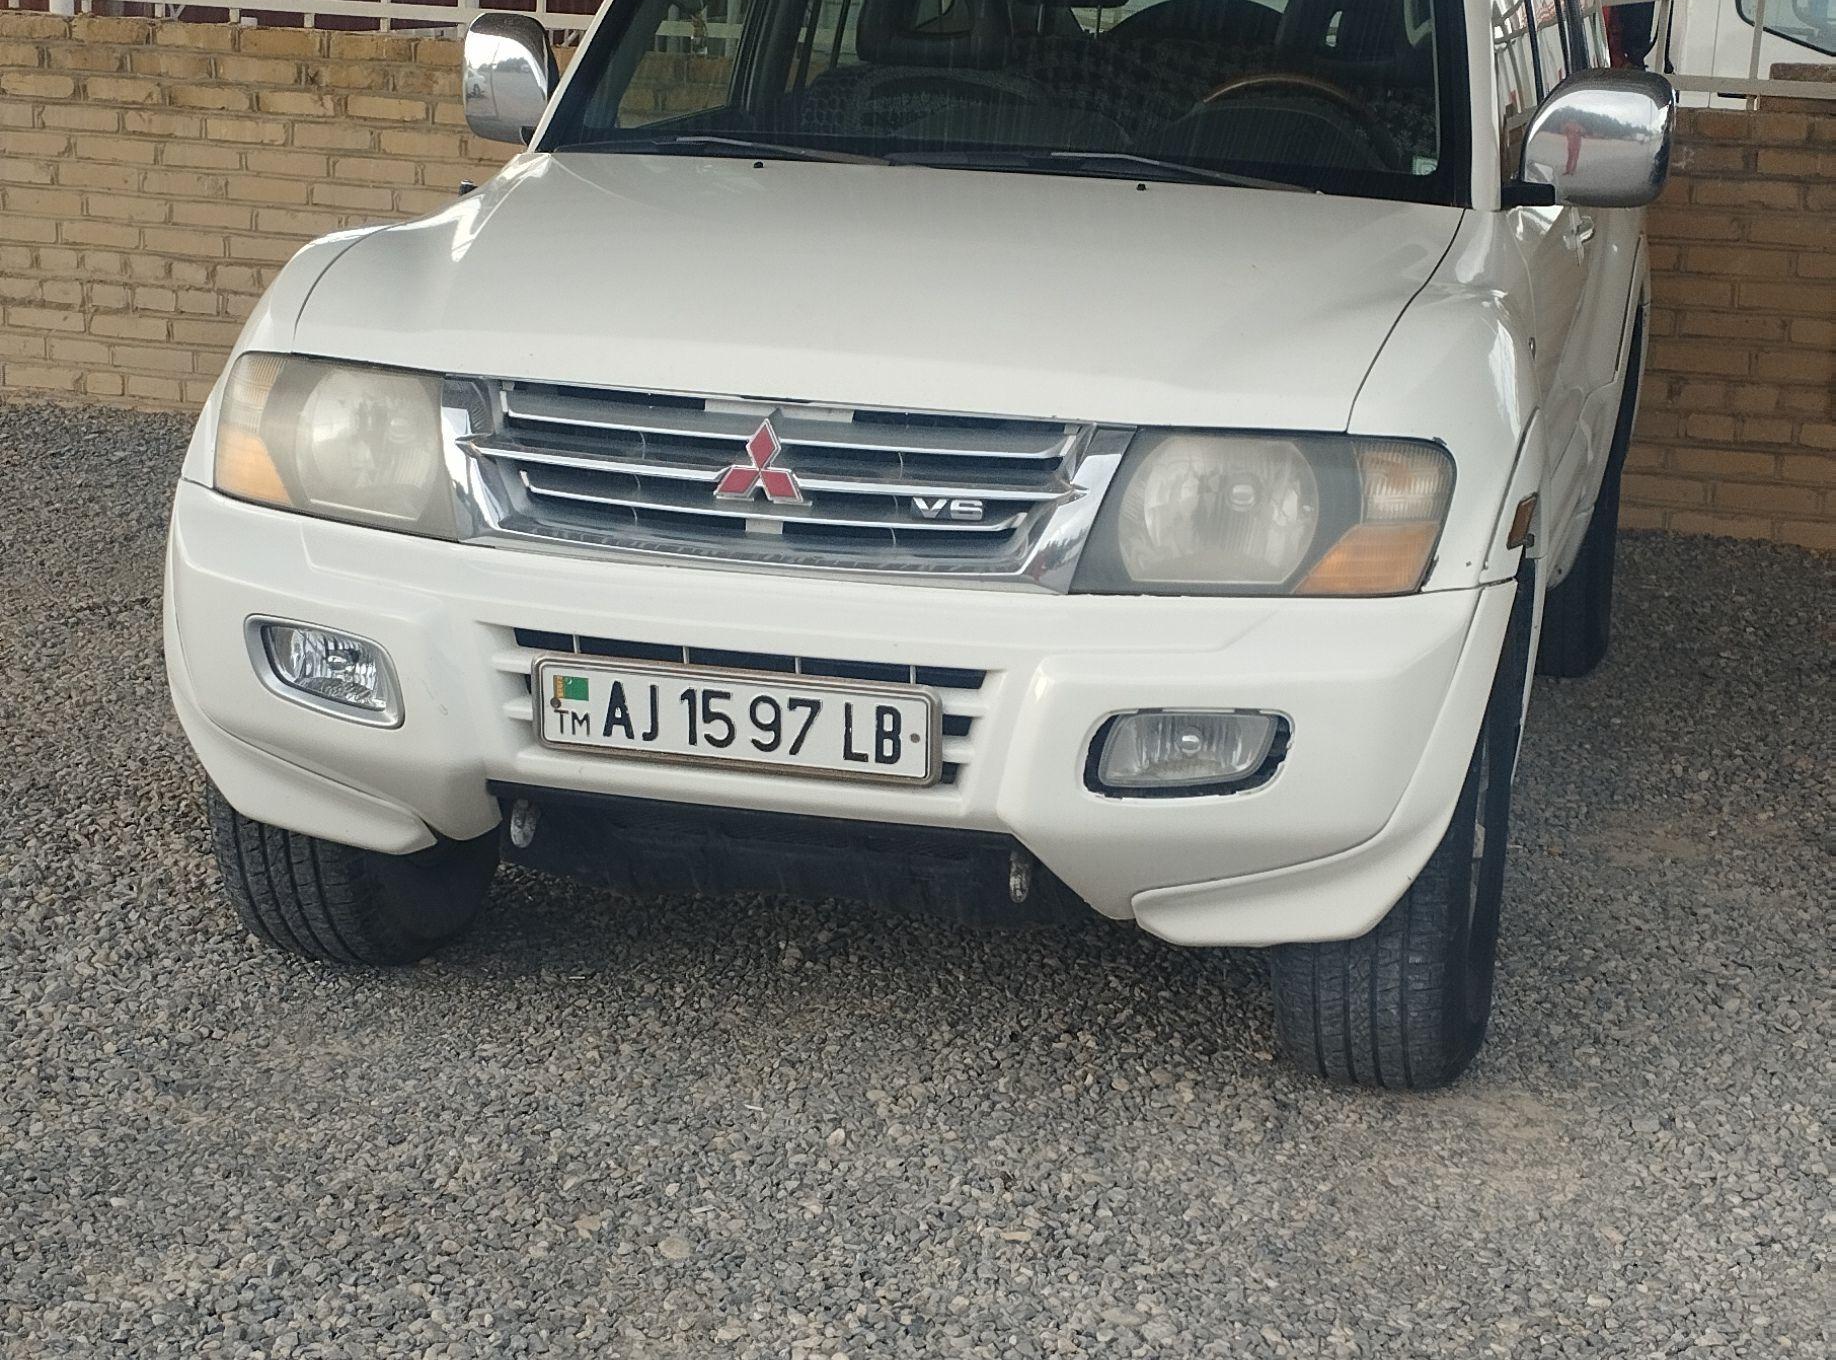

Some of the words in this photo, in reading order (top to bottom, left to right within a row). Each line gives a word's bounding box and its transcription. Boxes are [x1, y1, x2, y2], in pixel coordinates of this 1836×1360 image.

[912, 496, 983, 520] V6
[554, 709, 590, 736] TM
[603, 681, 659, 742] AJ
[843, 702, 901, 764] LB
